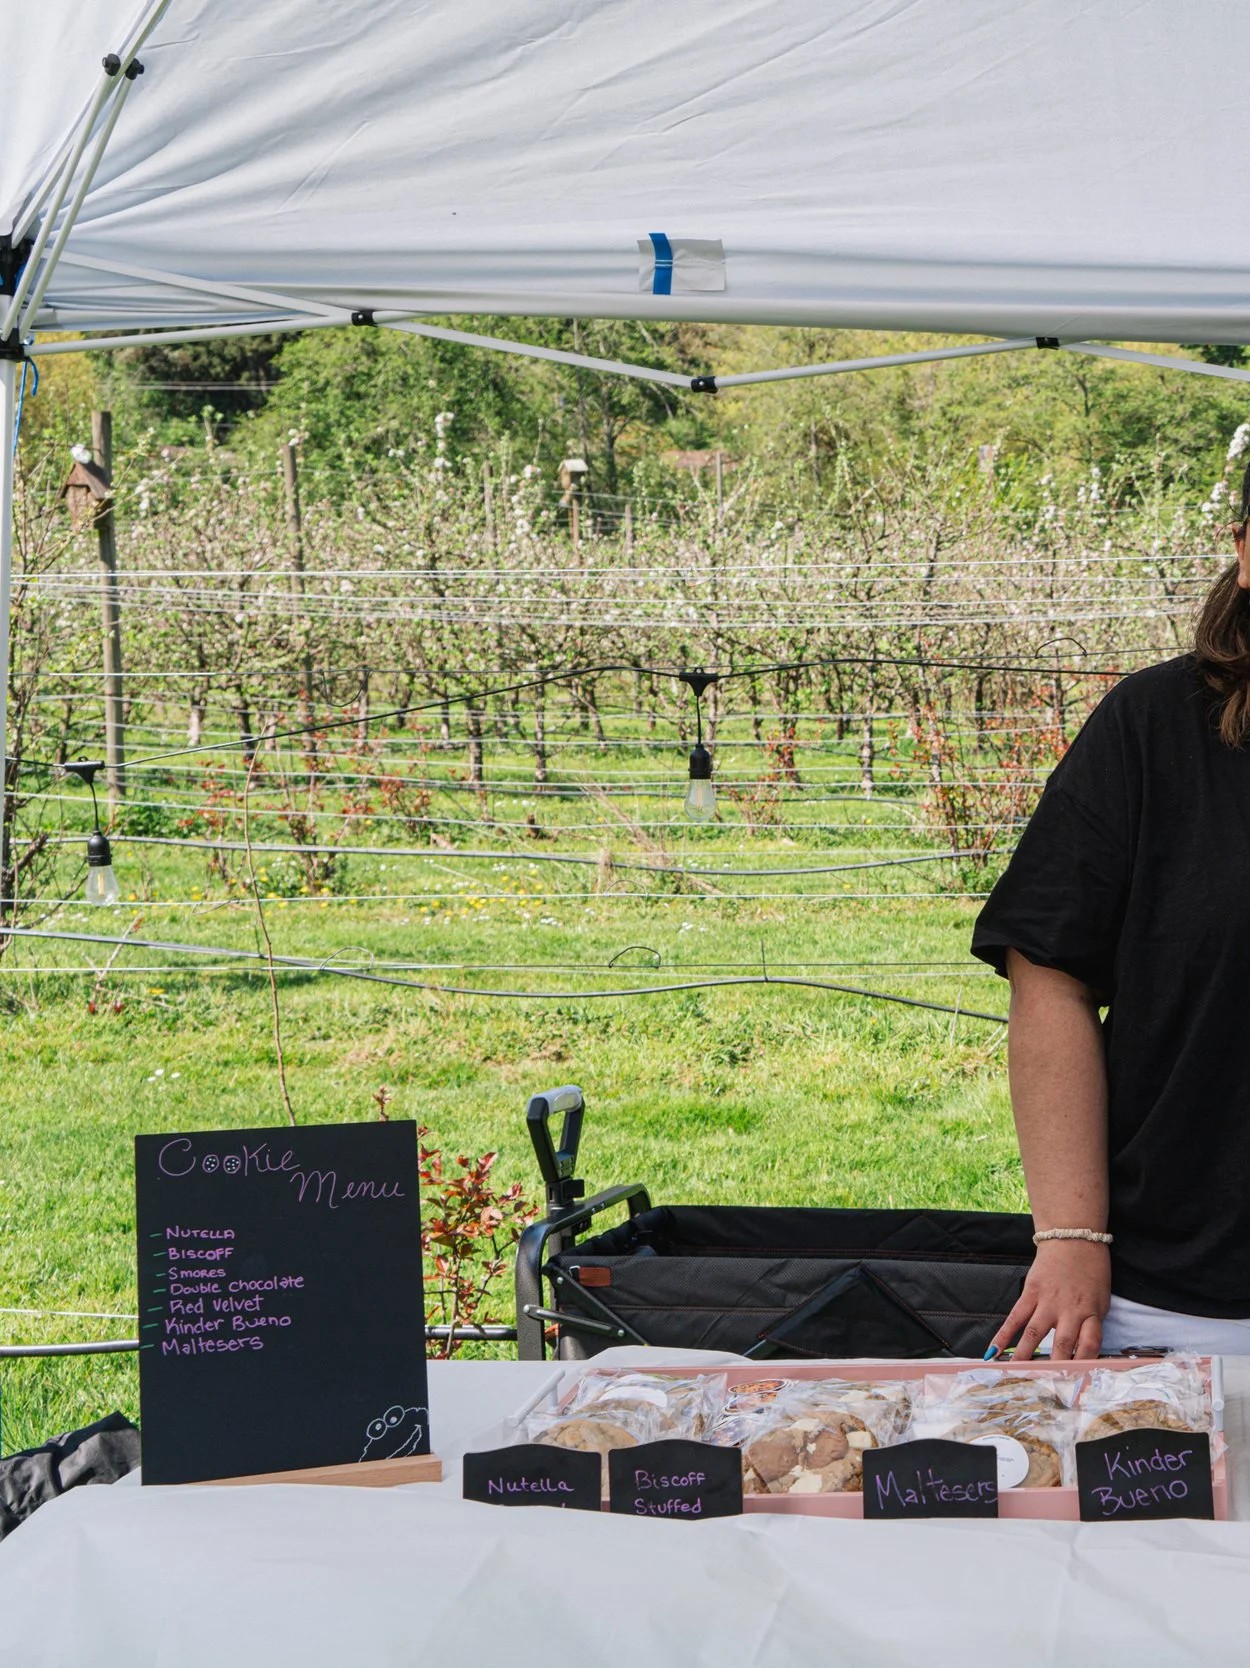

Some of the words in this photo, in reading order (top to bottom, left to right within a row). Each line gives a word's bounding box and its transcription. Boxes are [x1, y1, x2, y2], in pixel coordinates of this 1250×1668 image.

[290, 1170, 406, 1209] Menu
[170, 1282, 222, 1295] Double
[170, 1298, 204, 1315] Red
[165, 1317, 225, 1335] Kinder
[232, 1315, 292, 1331] Bueno
[161, 1336, 264, 1356] Maltesers
[1104, 1446, 1193, 1480] Kinder
[488, 1477, 575, 1495] Nutella
[634, 1470, 706, 1490] Biscoff
[875, 1468, 997, 1510] Maltesers
[634, 1498, 702, 1515] Stuffed
[1091, 1480, 1188, 1516] Bueno
